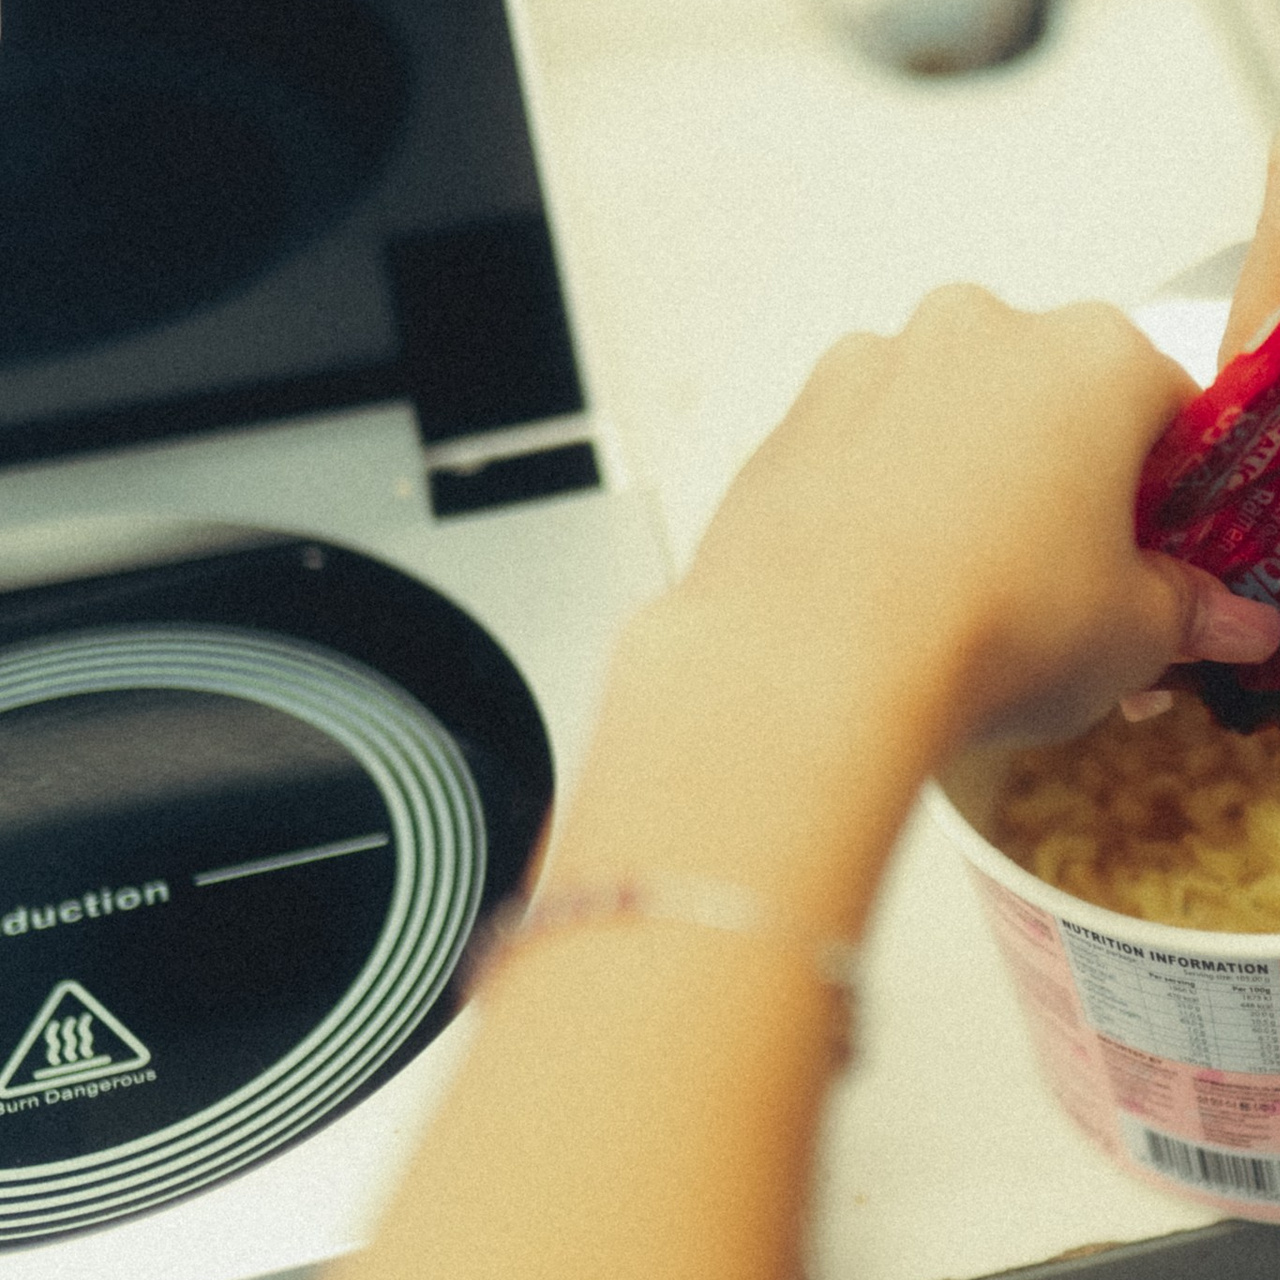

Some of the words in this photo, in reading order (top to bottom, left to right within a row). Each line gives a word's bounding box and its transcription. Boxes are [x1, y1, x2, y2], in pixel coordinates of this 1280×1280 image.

[1220, 485, 1276, 554] Ramen
[1060, 918, 1145, 959] NUTRITION
[1149, 950, 1269, 975] INFORMATION
[45, 1069, 157, 1105] Dangerous
